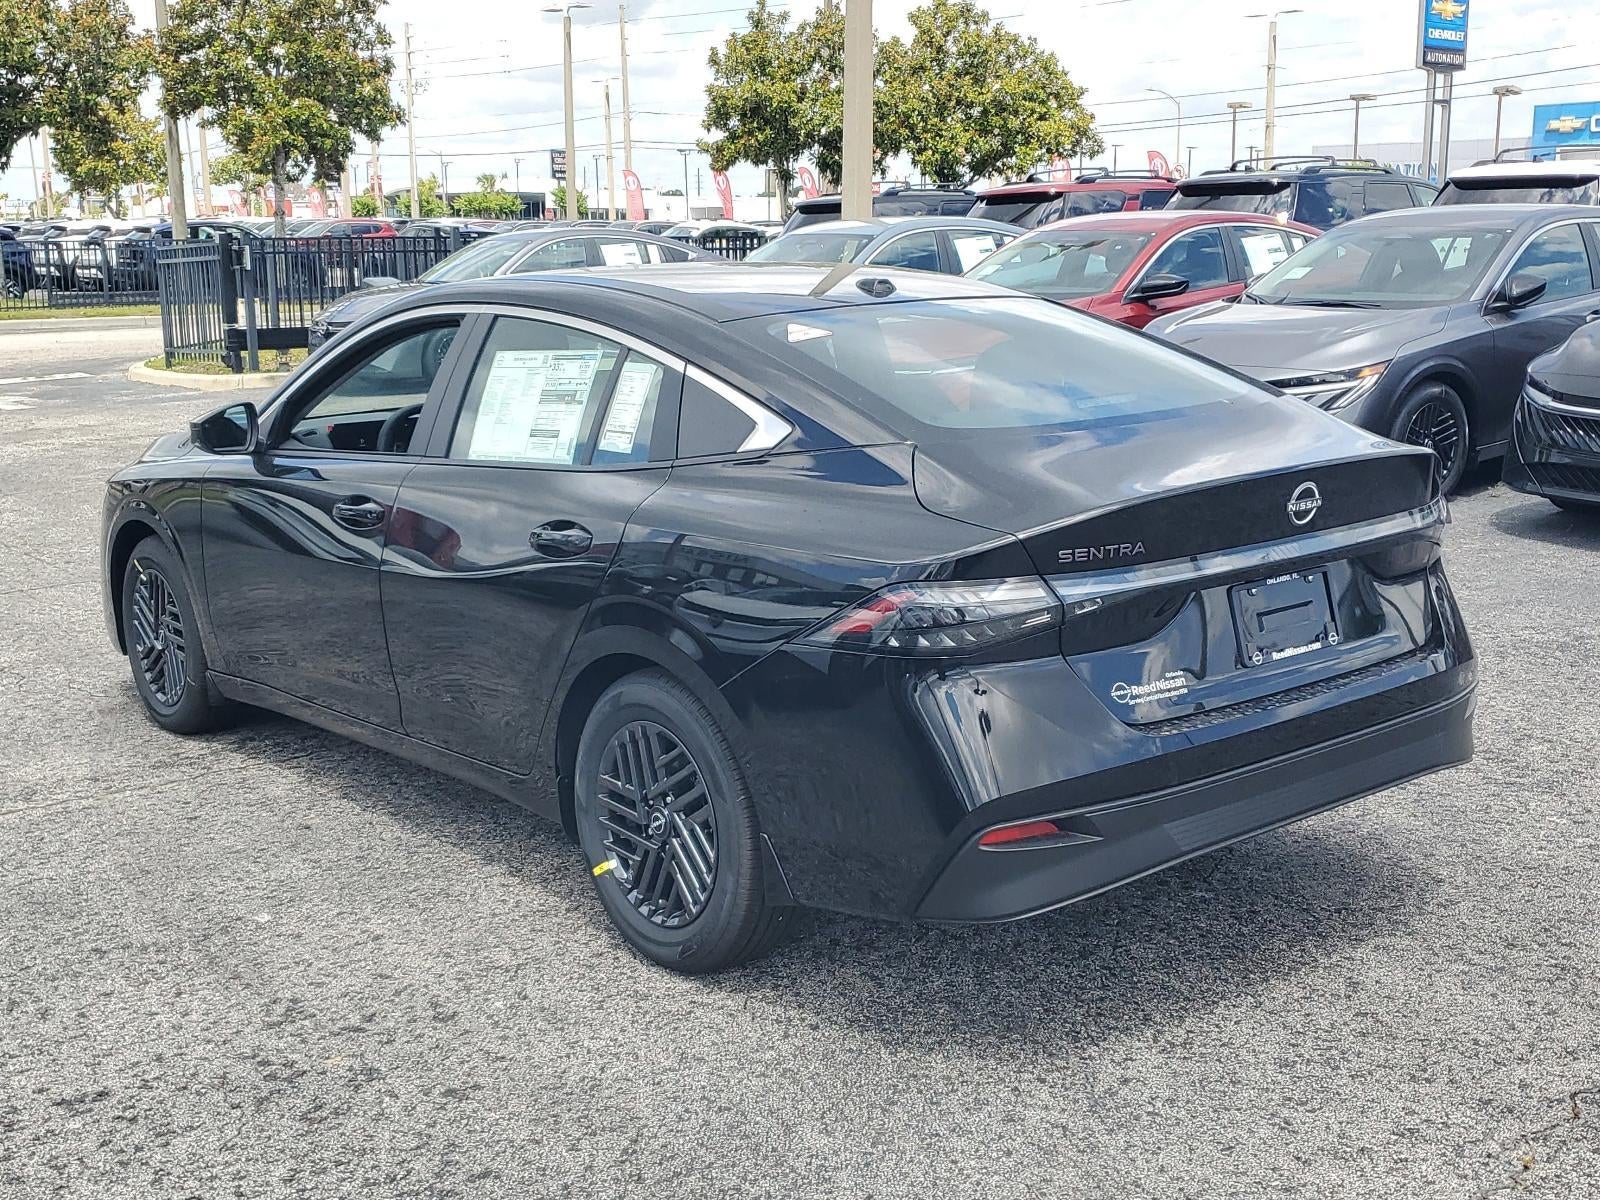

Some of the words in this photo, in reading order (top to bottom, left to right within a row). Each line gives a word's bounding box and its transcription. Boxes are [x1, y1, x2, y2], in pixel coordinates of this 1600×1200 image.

[1428, 28, 1465, 41] CHEVROLET
[1426, 52, 1464, 64] AUTONATION
[1288, 498, 1322, 512] NISSAN
[1058, 541, 1147, 564] SENTRA
[1272, 642, 1322, 661] ReedNissan.com
